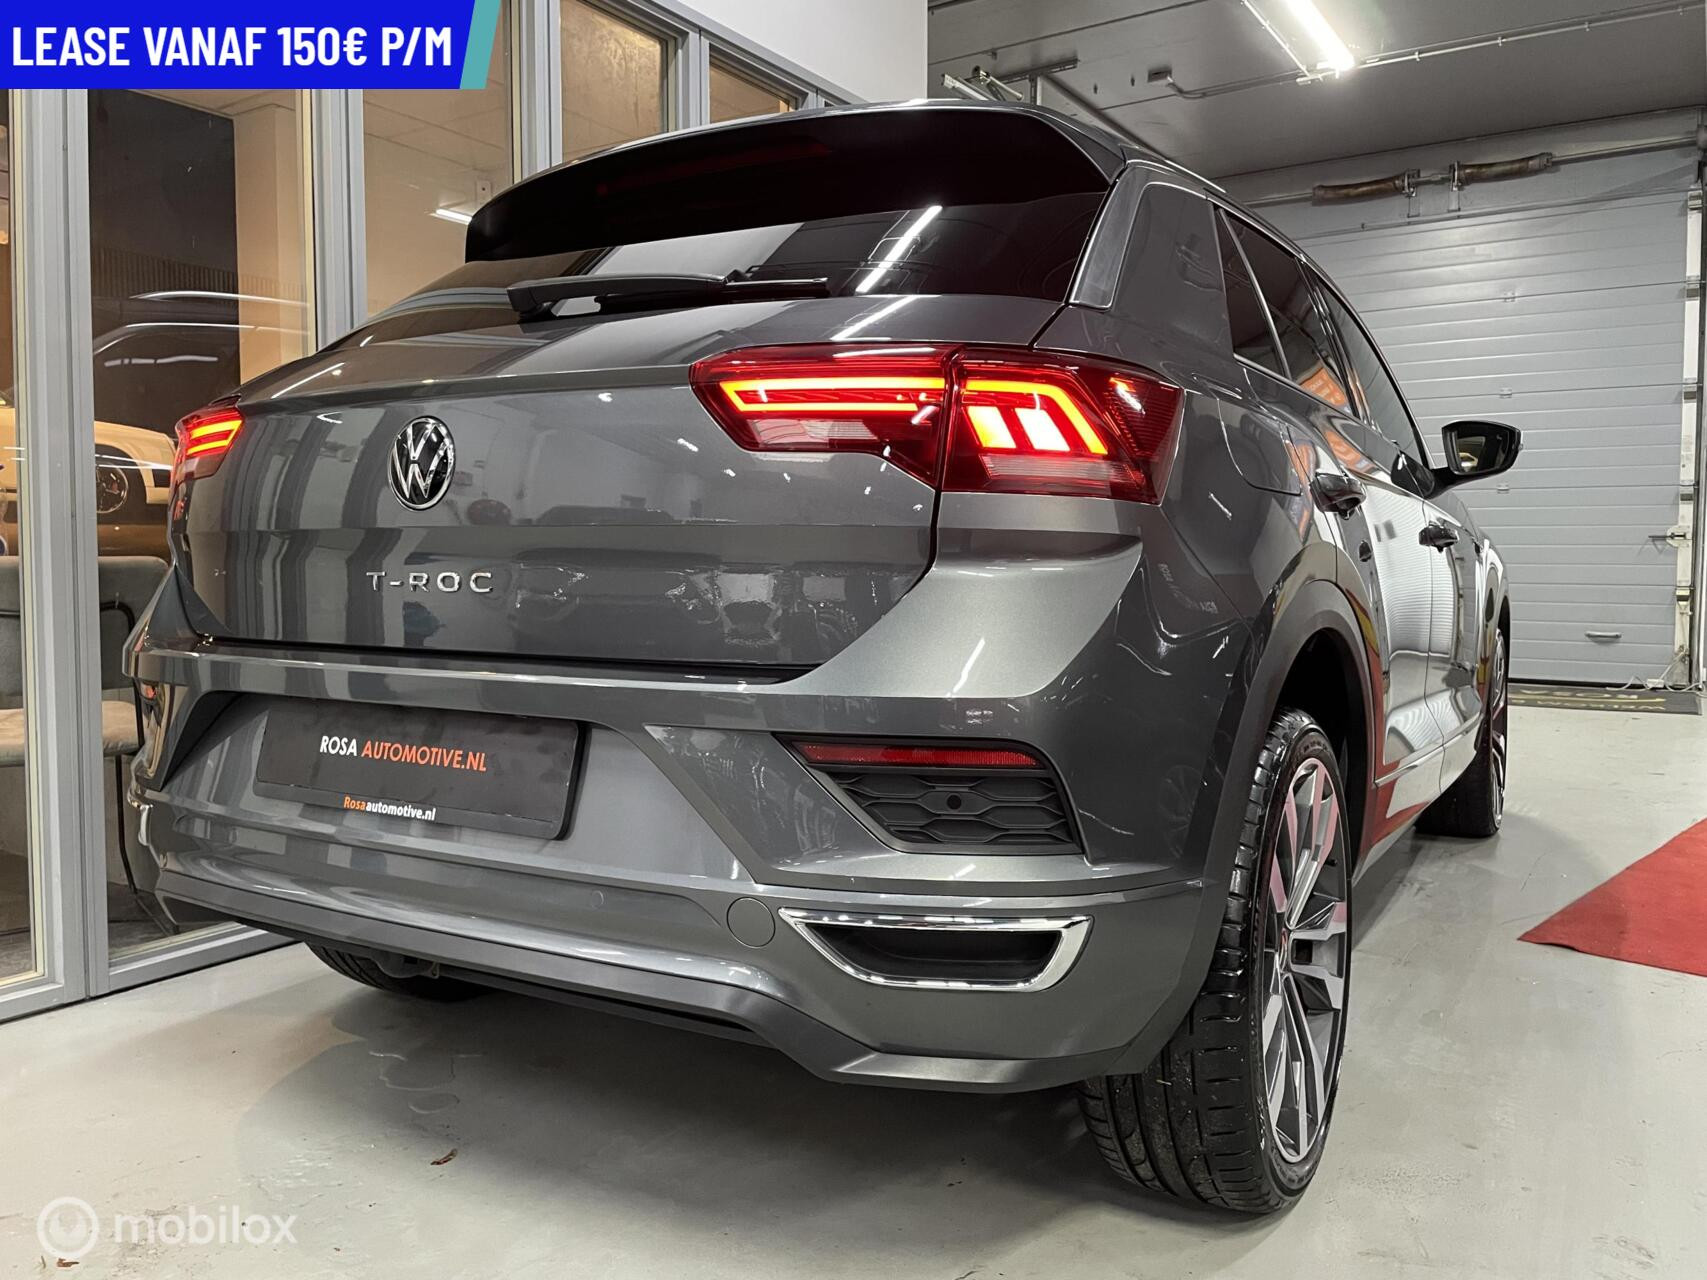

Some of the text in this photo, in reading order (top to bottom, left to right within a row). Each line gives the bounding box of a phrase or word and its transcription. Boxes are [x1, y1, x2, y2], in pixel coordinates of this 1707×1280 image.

[366, 571, 493, 593] T-ROC
[319, 735, 487, 773] ROSA AUTOMOTIVE.NL
[343, 795, 437, 823] Rosaautomotive.nl
